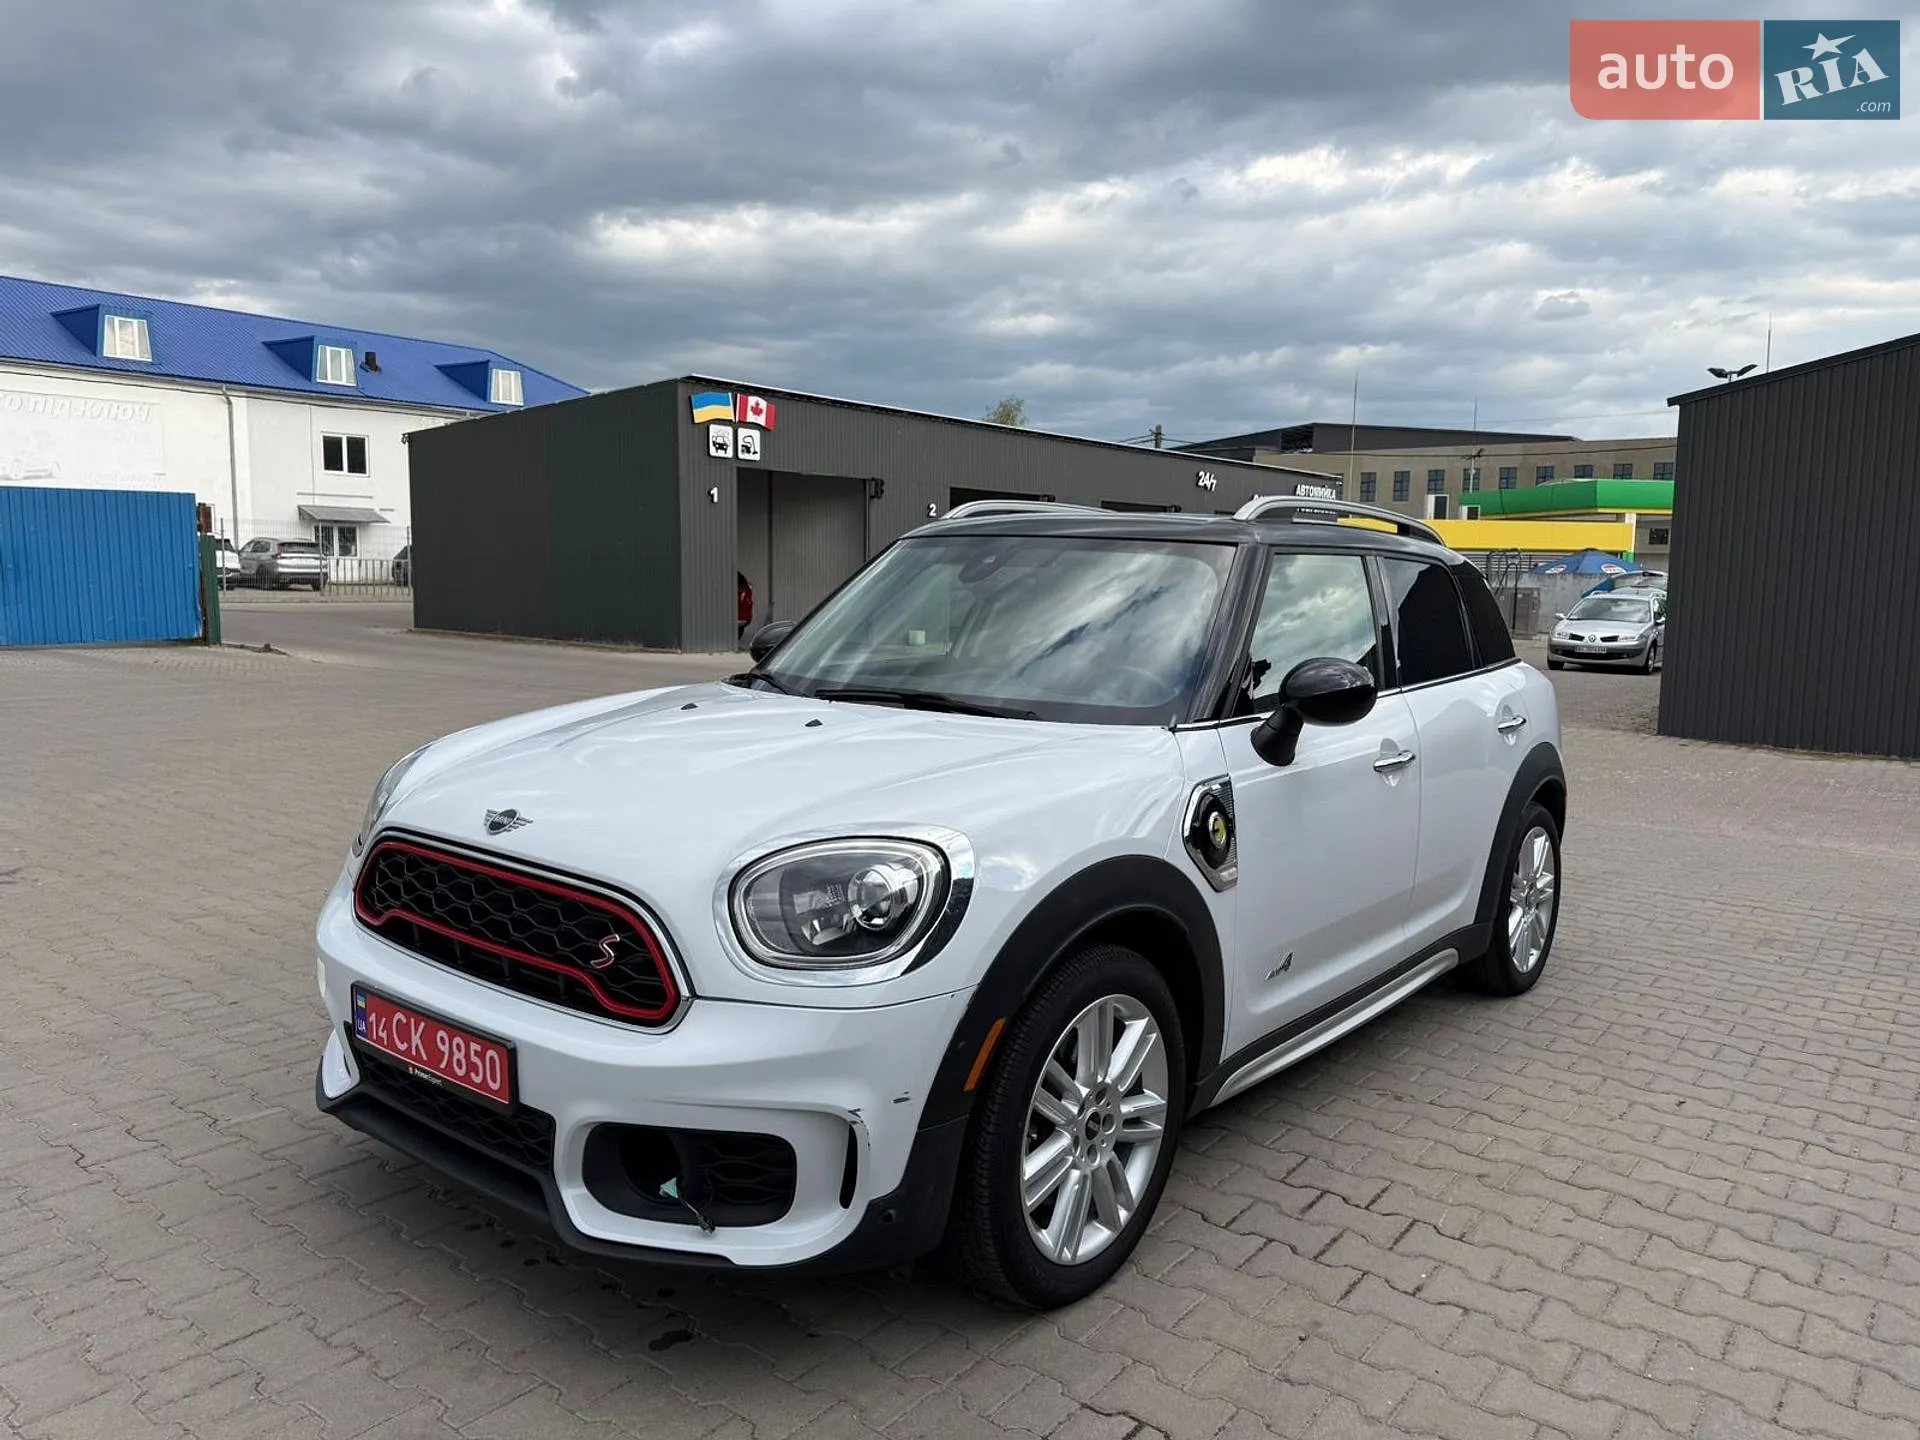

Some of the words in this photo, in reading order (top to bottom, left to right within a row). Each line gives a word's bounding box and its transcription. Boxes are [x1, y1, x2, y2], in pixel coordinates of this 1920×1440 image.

[1198, 471, 1217, 491] 24/7
[710, 487, 718, 502] 1
[928, 503, 937, 517] 2
[590, 933, 620, 969] S
[356, 1018, 367, 1033] UA
[436, 1030, 501, 1091] 9850
